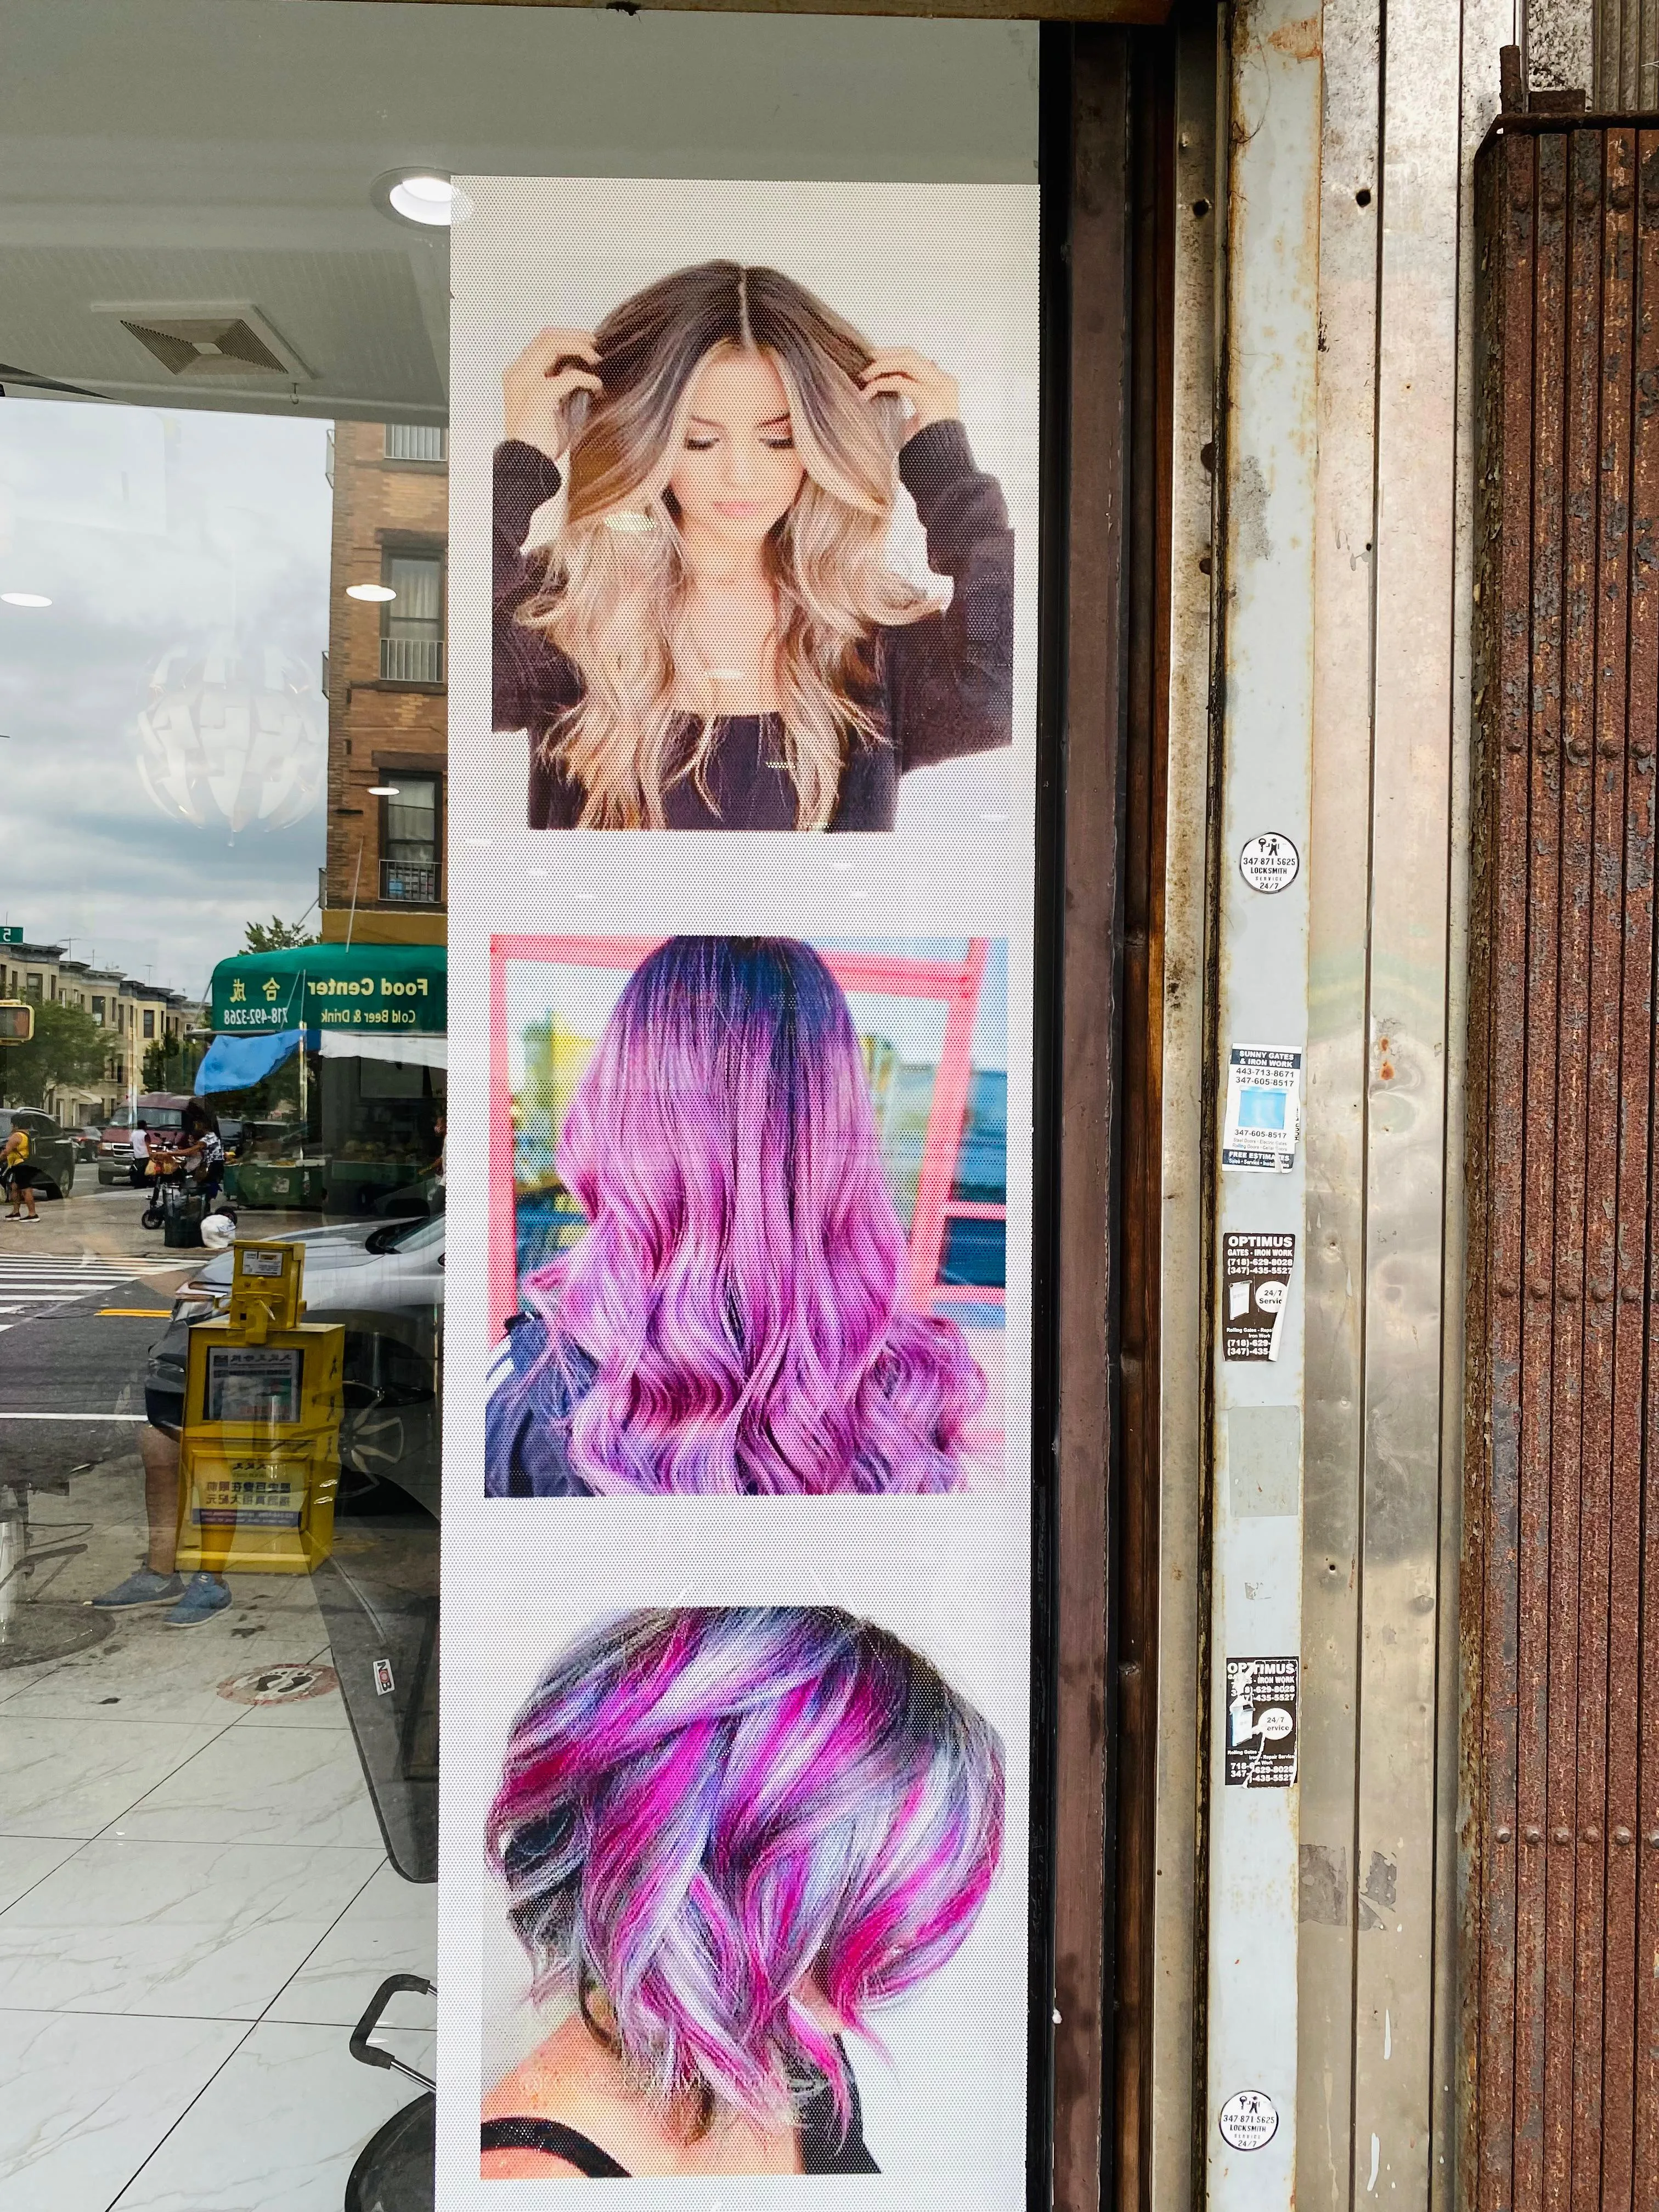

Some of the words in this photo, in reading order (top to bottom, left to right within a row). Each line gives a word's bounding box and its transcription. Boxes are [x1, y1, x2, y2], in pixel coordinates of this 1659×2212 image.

[1239, 1050, 1267, 1059] SUNNY
[1268, 1052, 1294, 1060] GATES
[1269, 1059, 1293, 1068] WORK
[1235, 1068, 1294, 1078] 443-713-8671
[1235, 1076, 1295, 1087] 347-605-8517
[1234, 1129, 1287, 1139] 347-605-8517
[1228, 1236, 1293, 1247] OPTIMUS
[1227, 1259, 1293, 1267] (718)-629-8028
[1227, 1267, 1292, 1275] (347)-435-5527
[1227, 1339, 1271, 1347] (718)-629-
[1227, 1347, 1270, 1356] (347)-435-
